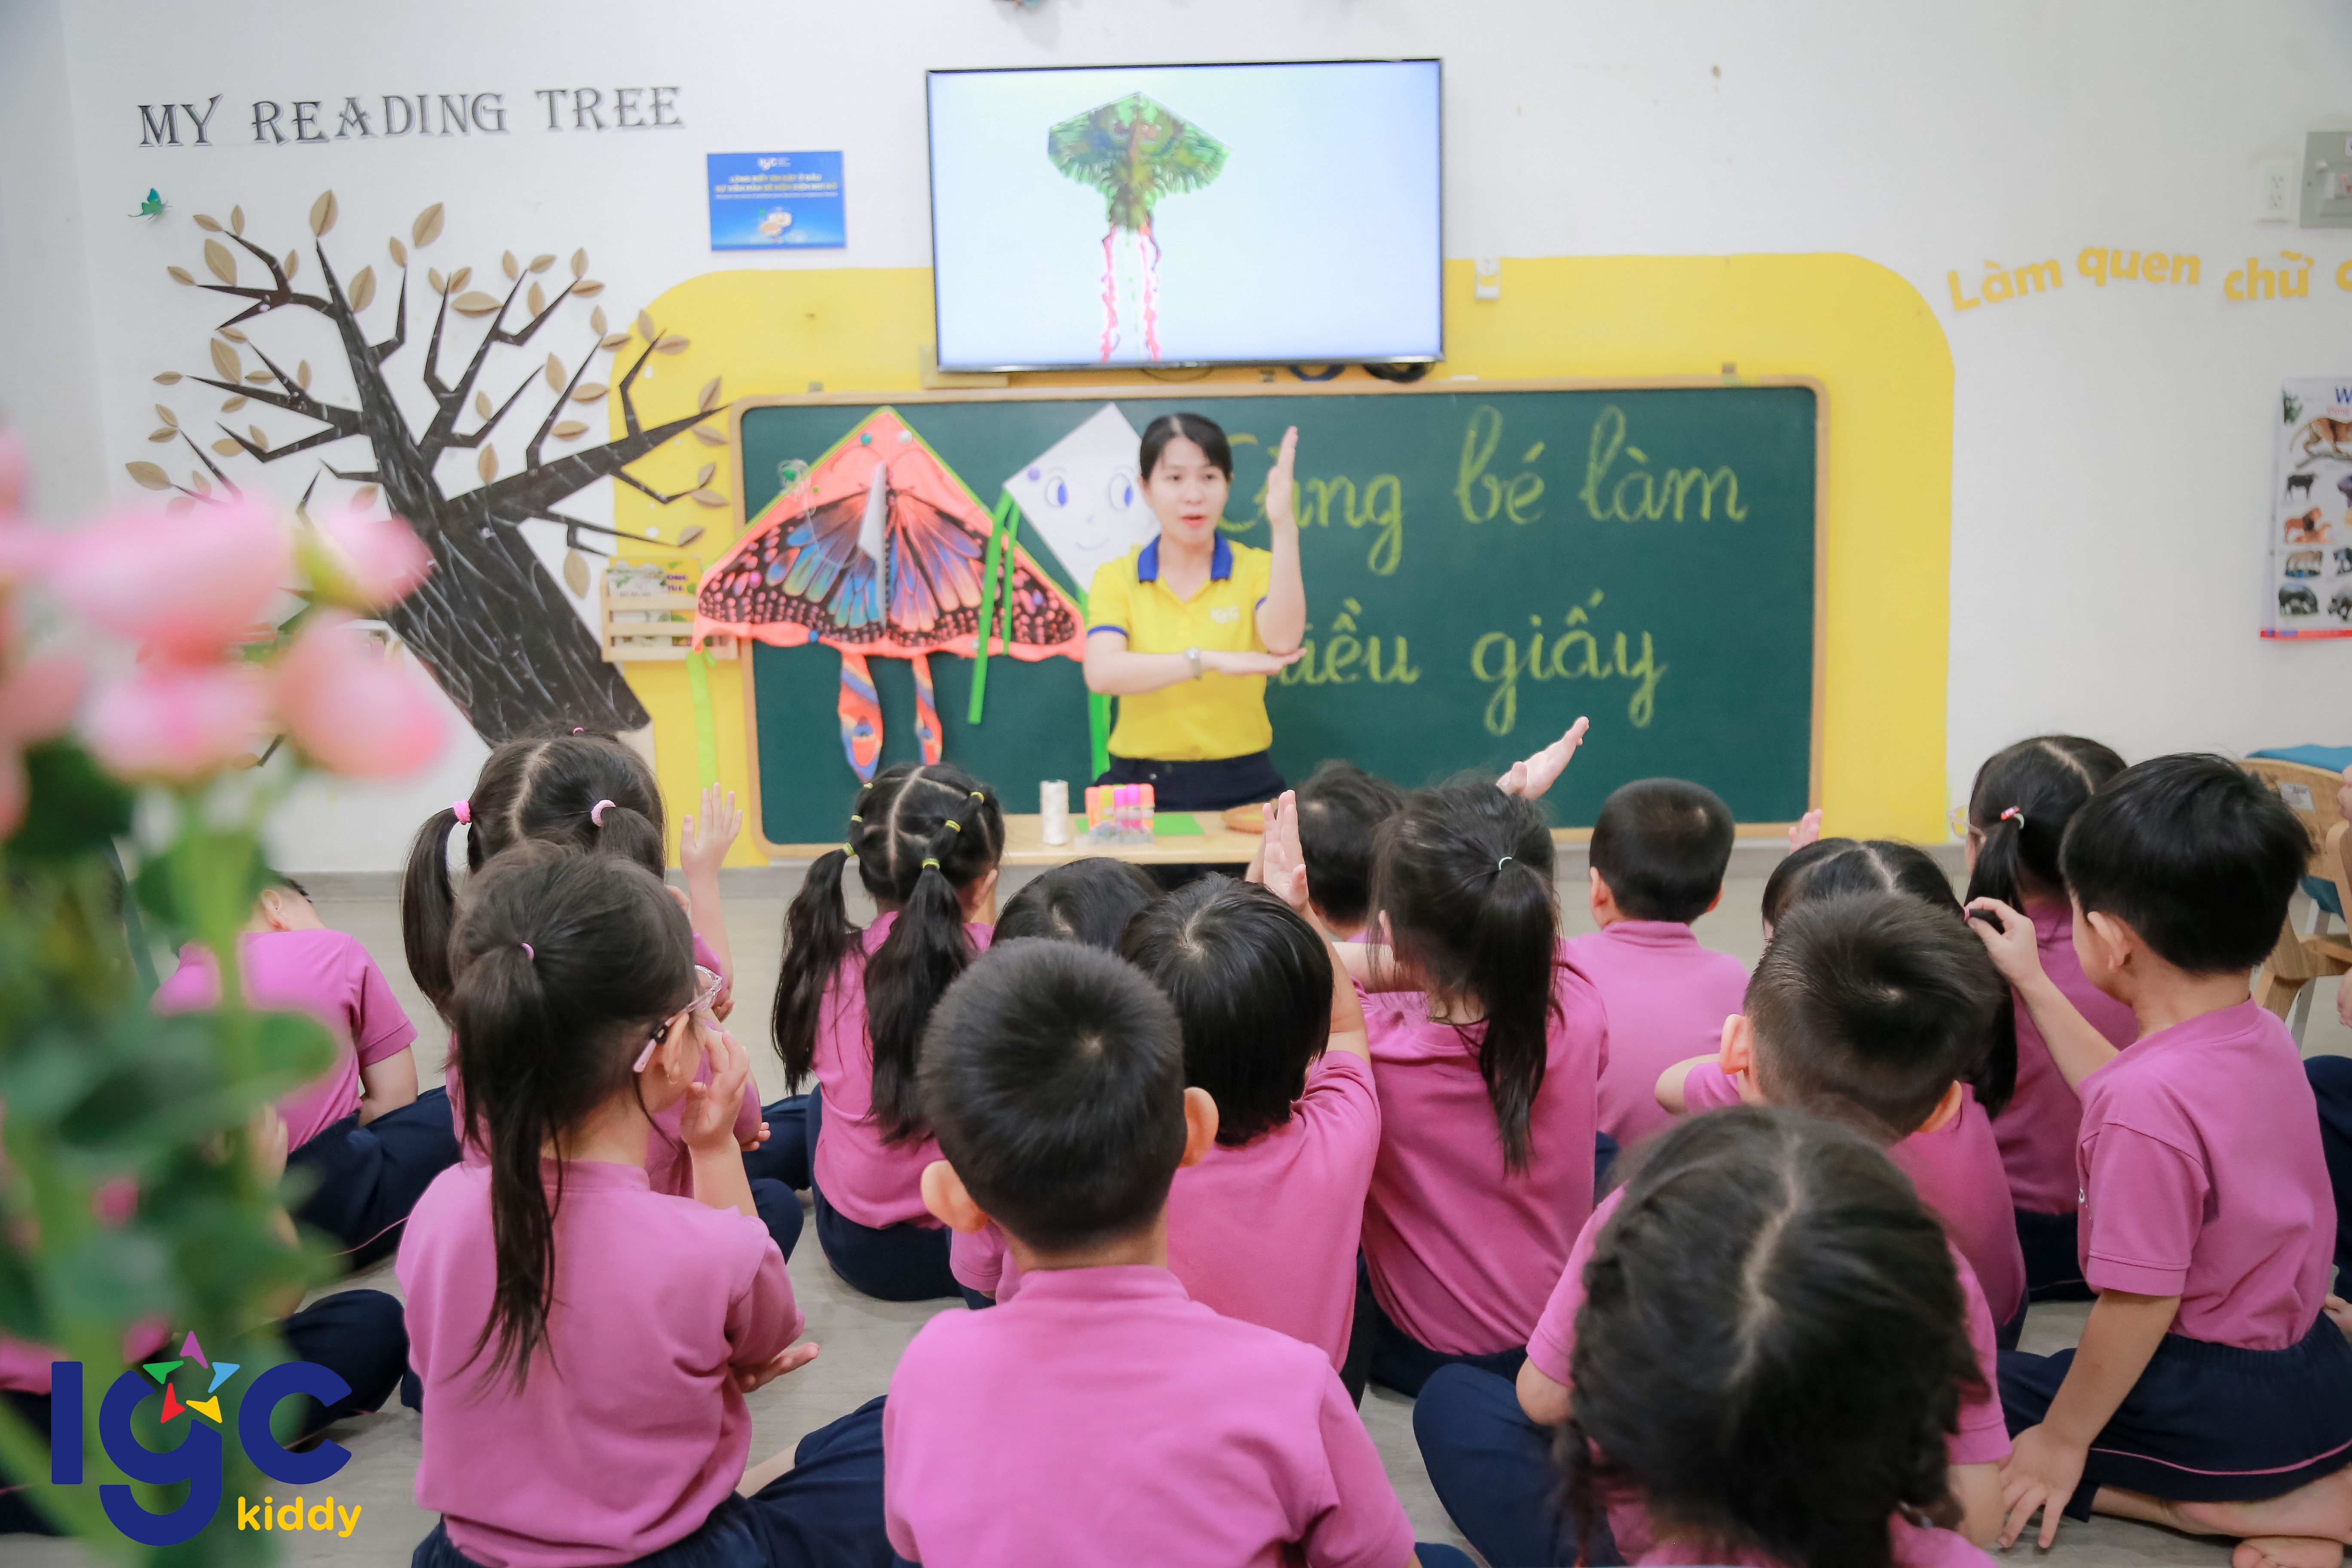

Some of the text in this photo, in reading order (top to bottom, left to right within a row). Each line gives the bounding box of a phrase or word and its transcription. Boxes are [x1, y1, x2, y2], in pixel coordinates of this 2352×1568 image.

[137, 85, 686, 147] MY READING TREE
[1947, 259, 2063, 312] Làm
[2077, 247, 2201, 286] quen
[2224, 250, 2315, 301] chữ
[1455, 404, 1544, 524] bé
[1579, 404, 1749, 522] làm
[1470, 589, 1668, 736] giấy
